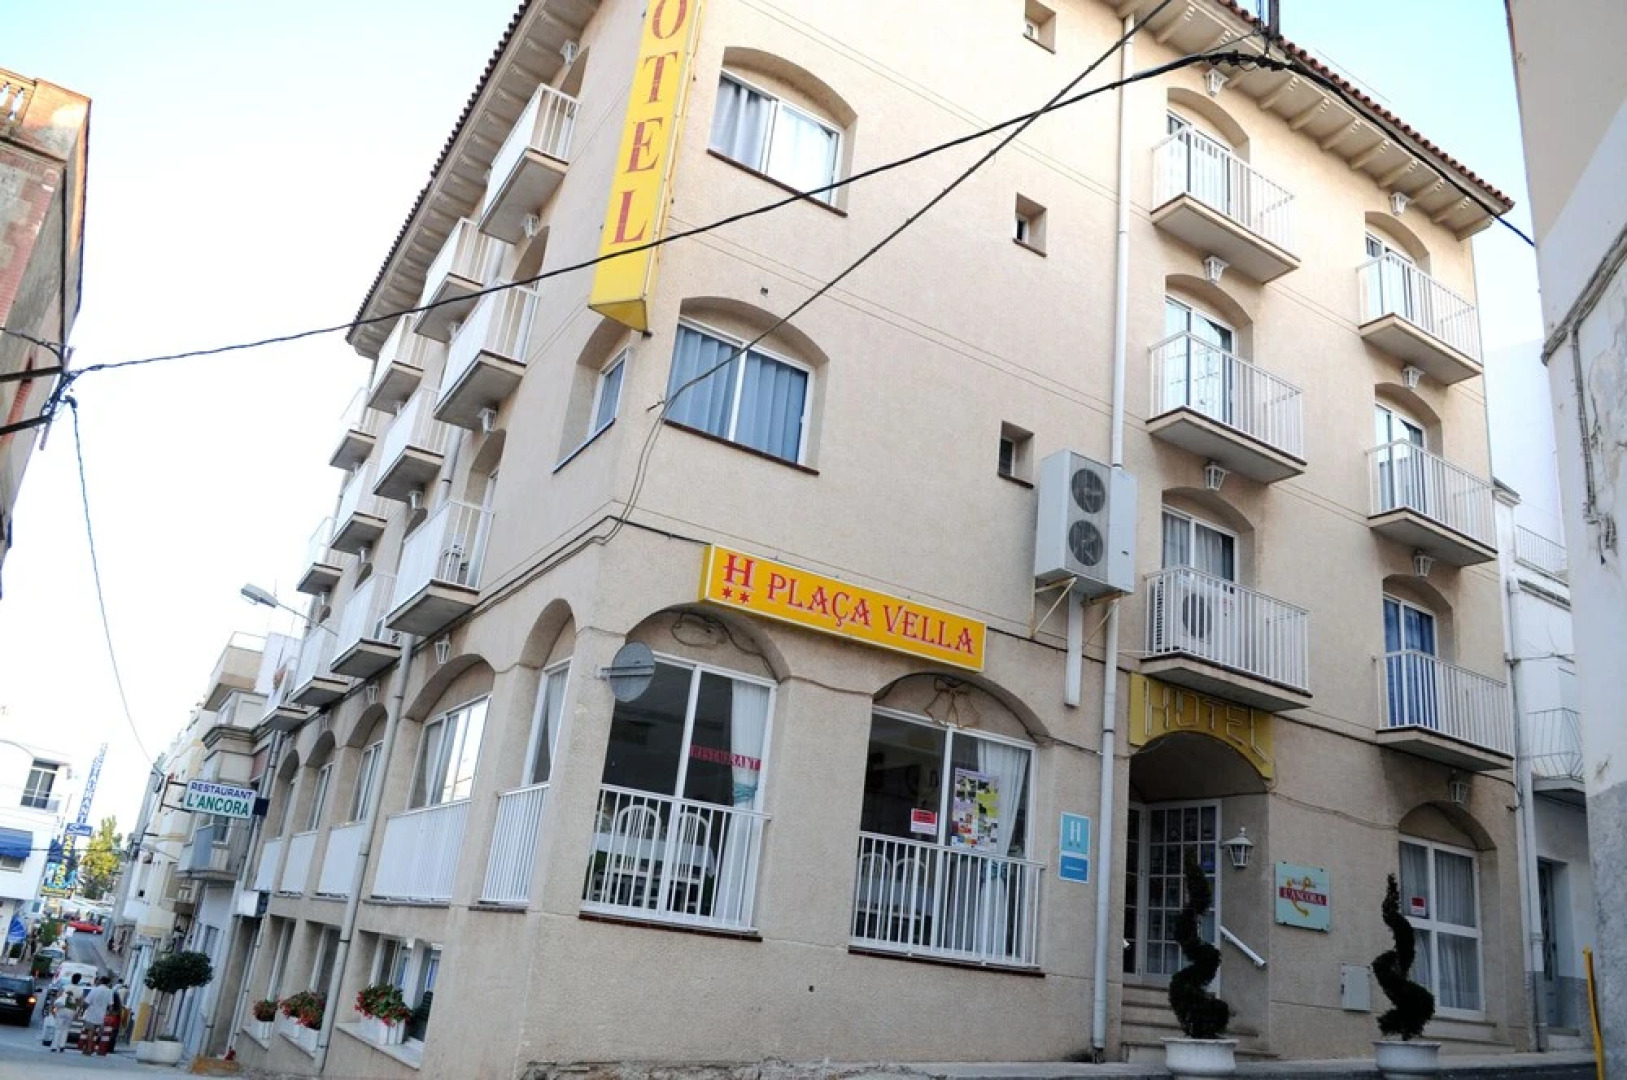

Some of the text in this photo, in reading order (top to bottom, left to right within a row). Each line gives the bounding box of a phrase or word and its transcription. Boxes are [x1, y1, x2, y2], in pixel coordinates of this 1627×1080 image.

[723, 553, 975, 655] H PLAÇA VELLA
[1144, 679, 1272, 764] HOTEL
[191, 781, 253, 800] RESTAURANT
[186, 793, 249, 816] L'ANCORA
[1069, 820, 1081, 842] H
